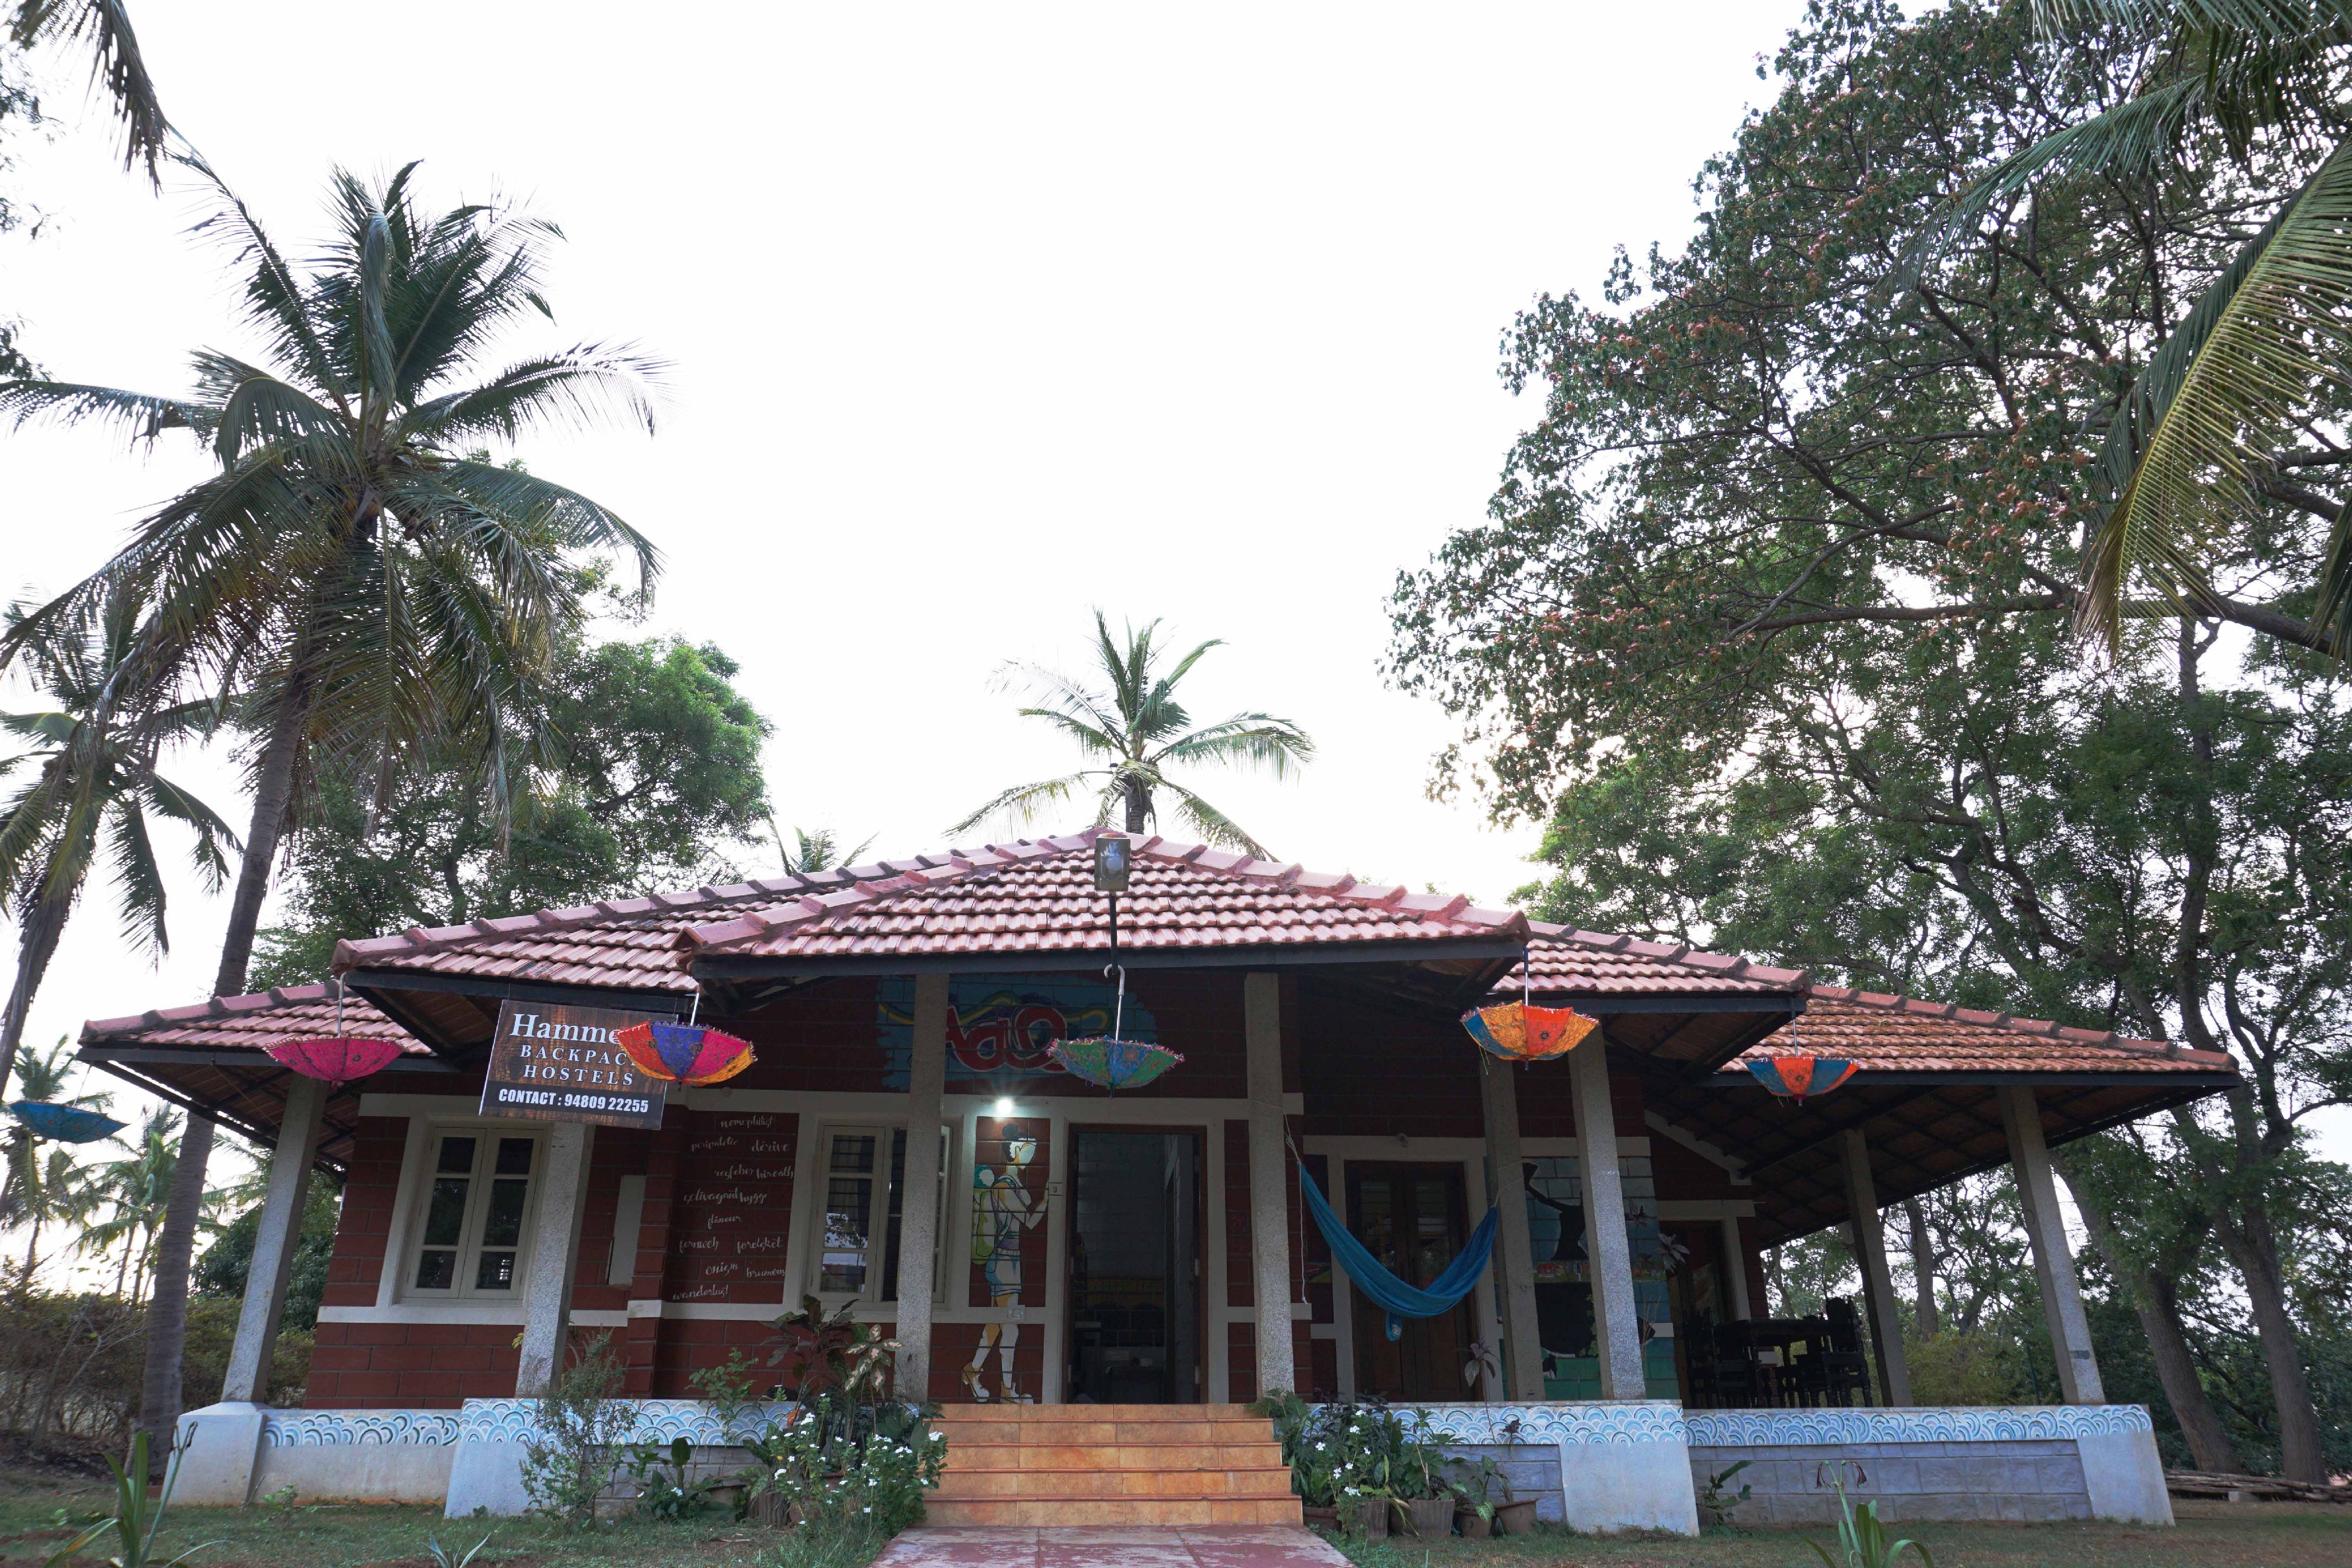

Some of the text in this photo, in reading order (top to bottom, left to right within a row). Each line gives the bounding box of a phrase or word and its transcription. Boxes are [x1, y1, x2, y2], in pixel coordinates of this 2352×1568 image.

[520, 1044, 636, 1066] BACKPAC
[523, 1065, 634, 1085] HOSTELS
[564, 1094, 606, 1109] 94809
[608, 1098, 649, 1113] 22255
[672, 1284, 729, 1301] wanderlust
